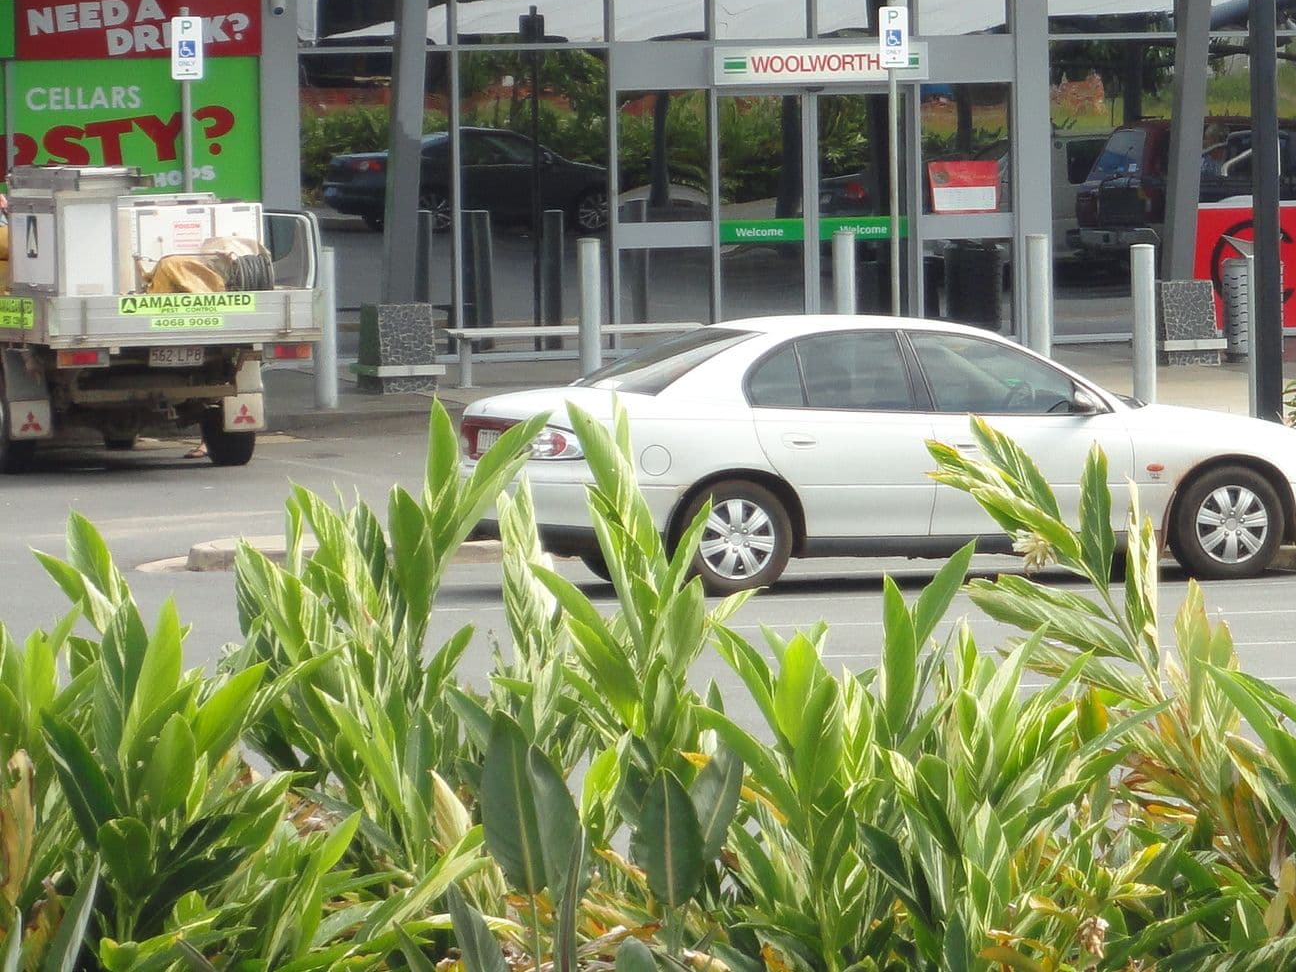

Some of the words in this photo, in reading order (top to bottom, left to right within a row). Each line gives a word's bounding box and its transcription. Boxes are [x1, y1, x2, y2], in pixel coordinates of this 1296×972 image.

[888, 10, 899, 24] P
[106, 12, 250, 56] DRIK?
[181, 20, 192, 34] P
[751, 53, 888, 73] WOOLWORTH
[25, 86, 142, 111] CELLARS
[735, 227, 784, 237] Welcome
[138, 294, 251, 309] AMALGAMATED
[154, 318, 185, 327] 4068
[188, 317, 220, 326] 9069
